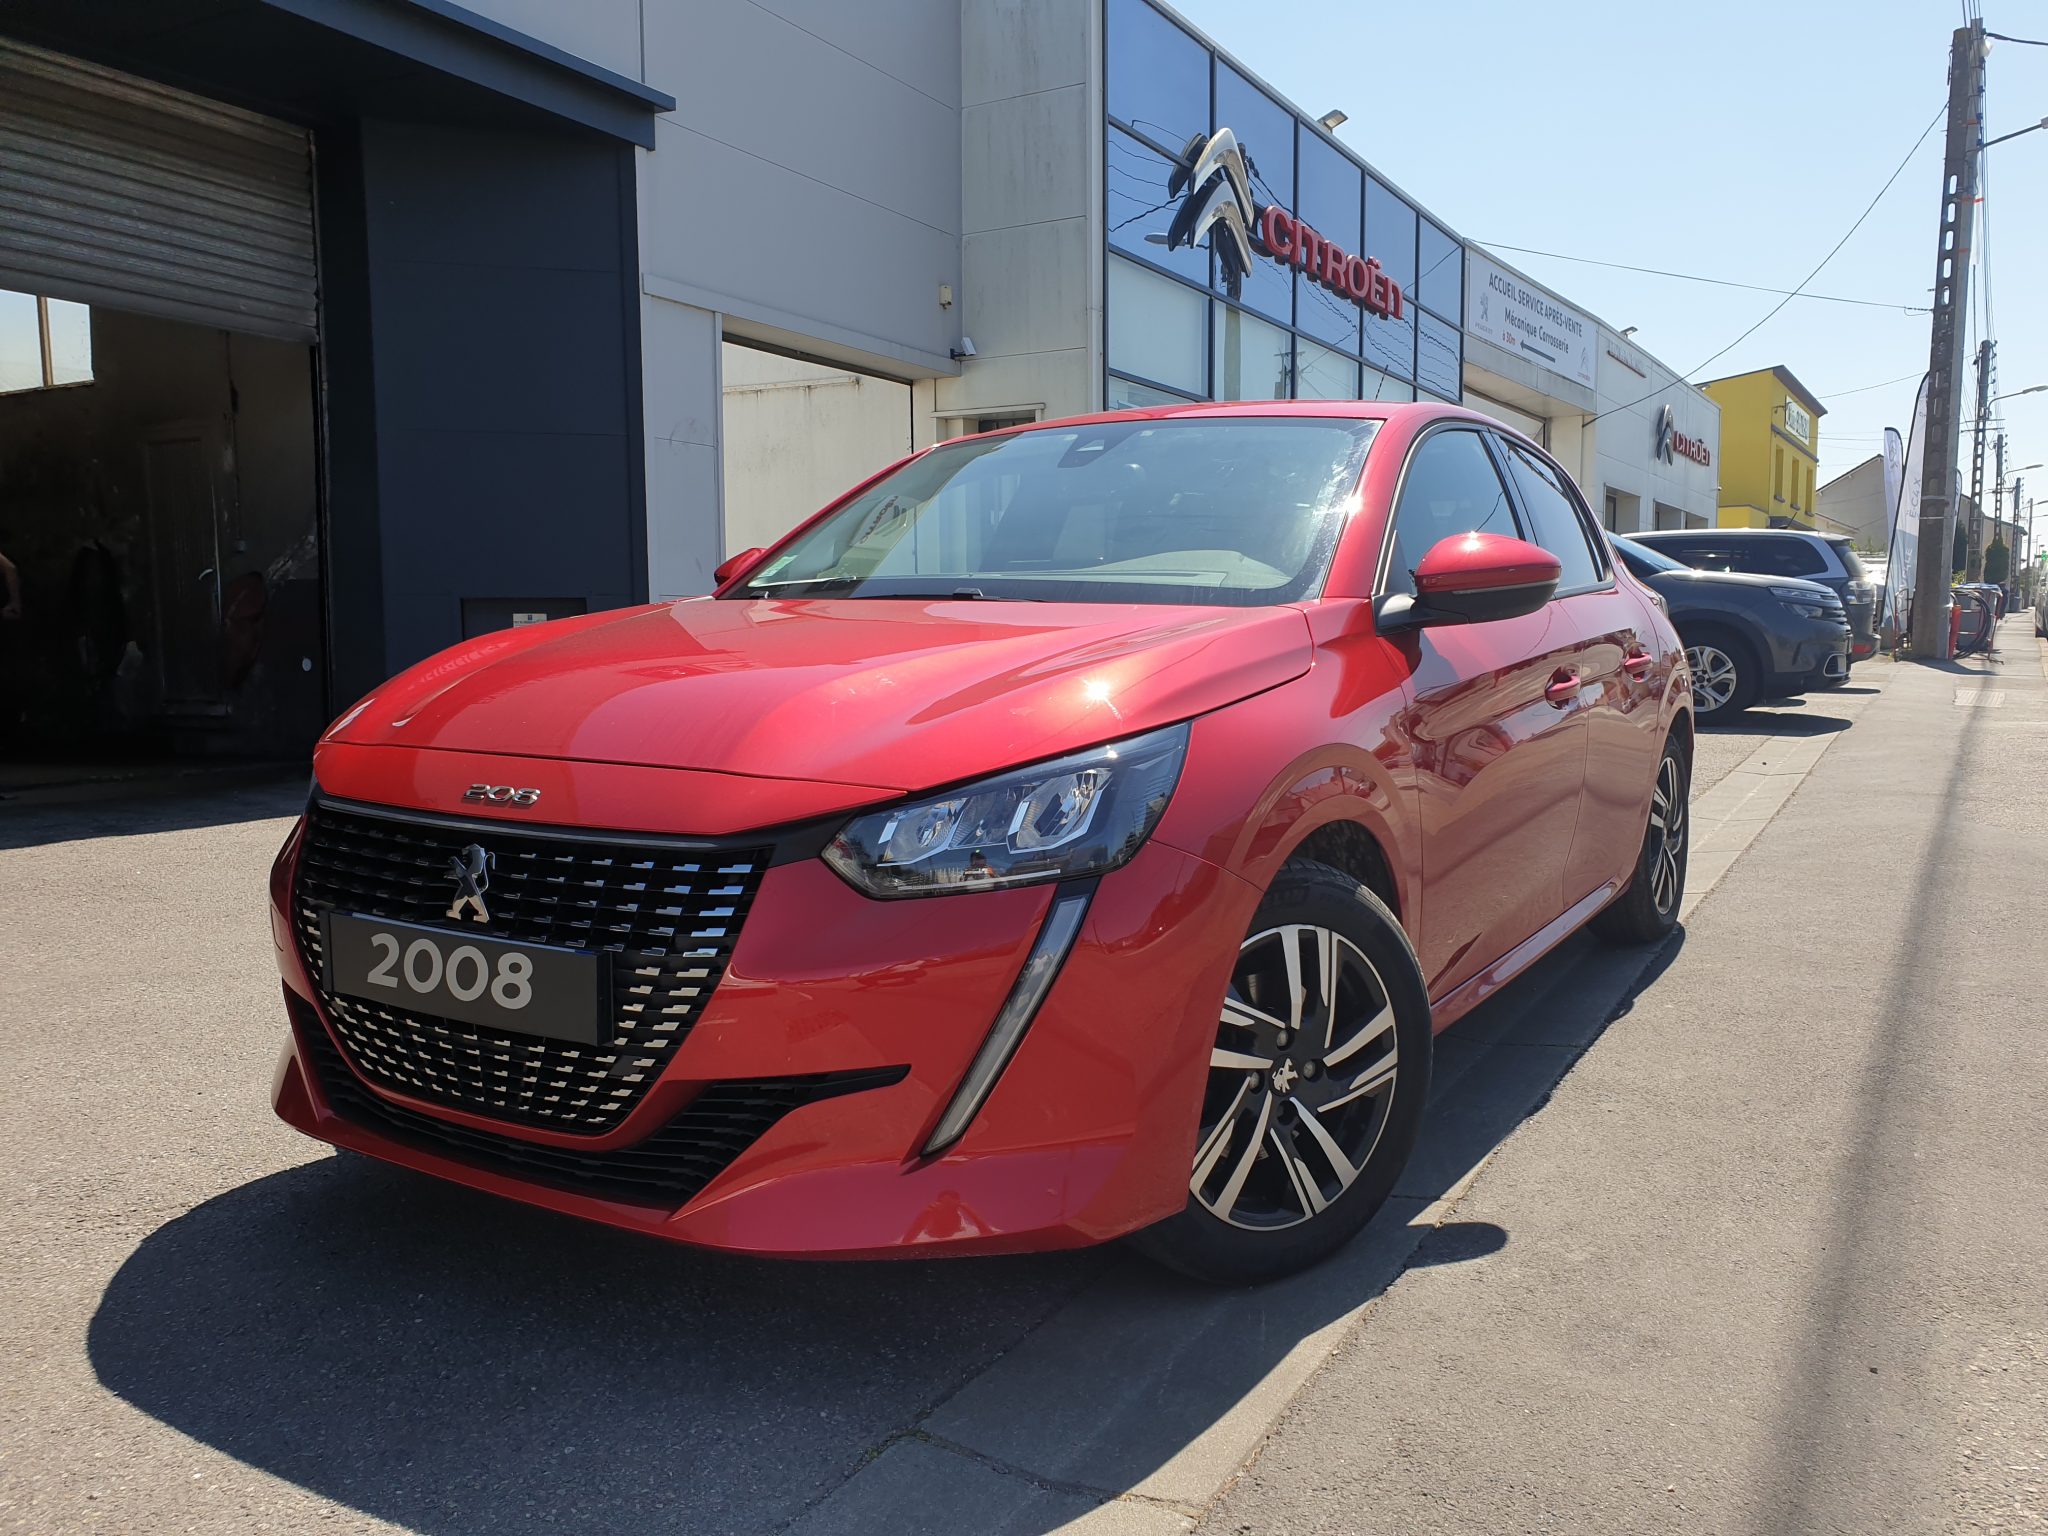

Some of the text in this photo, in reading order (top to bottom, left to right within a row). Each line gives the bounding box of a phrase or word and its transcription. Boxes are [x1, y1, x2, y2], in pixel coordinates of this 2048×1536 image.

[1489, 272, 1582, 338] ACCUEIL SERVICE APRÈS-VENTE
[1505, 307, 1569, 354] Mécanique Carrosserie
[465, 783, 541, 806] 208
[367, 932, 534, 1010] 2008
